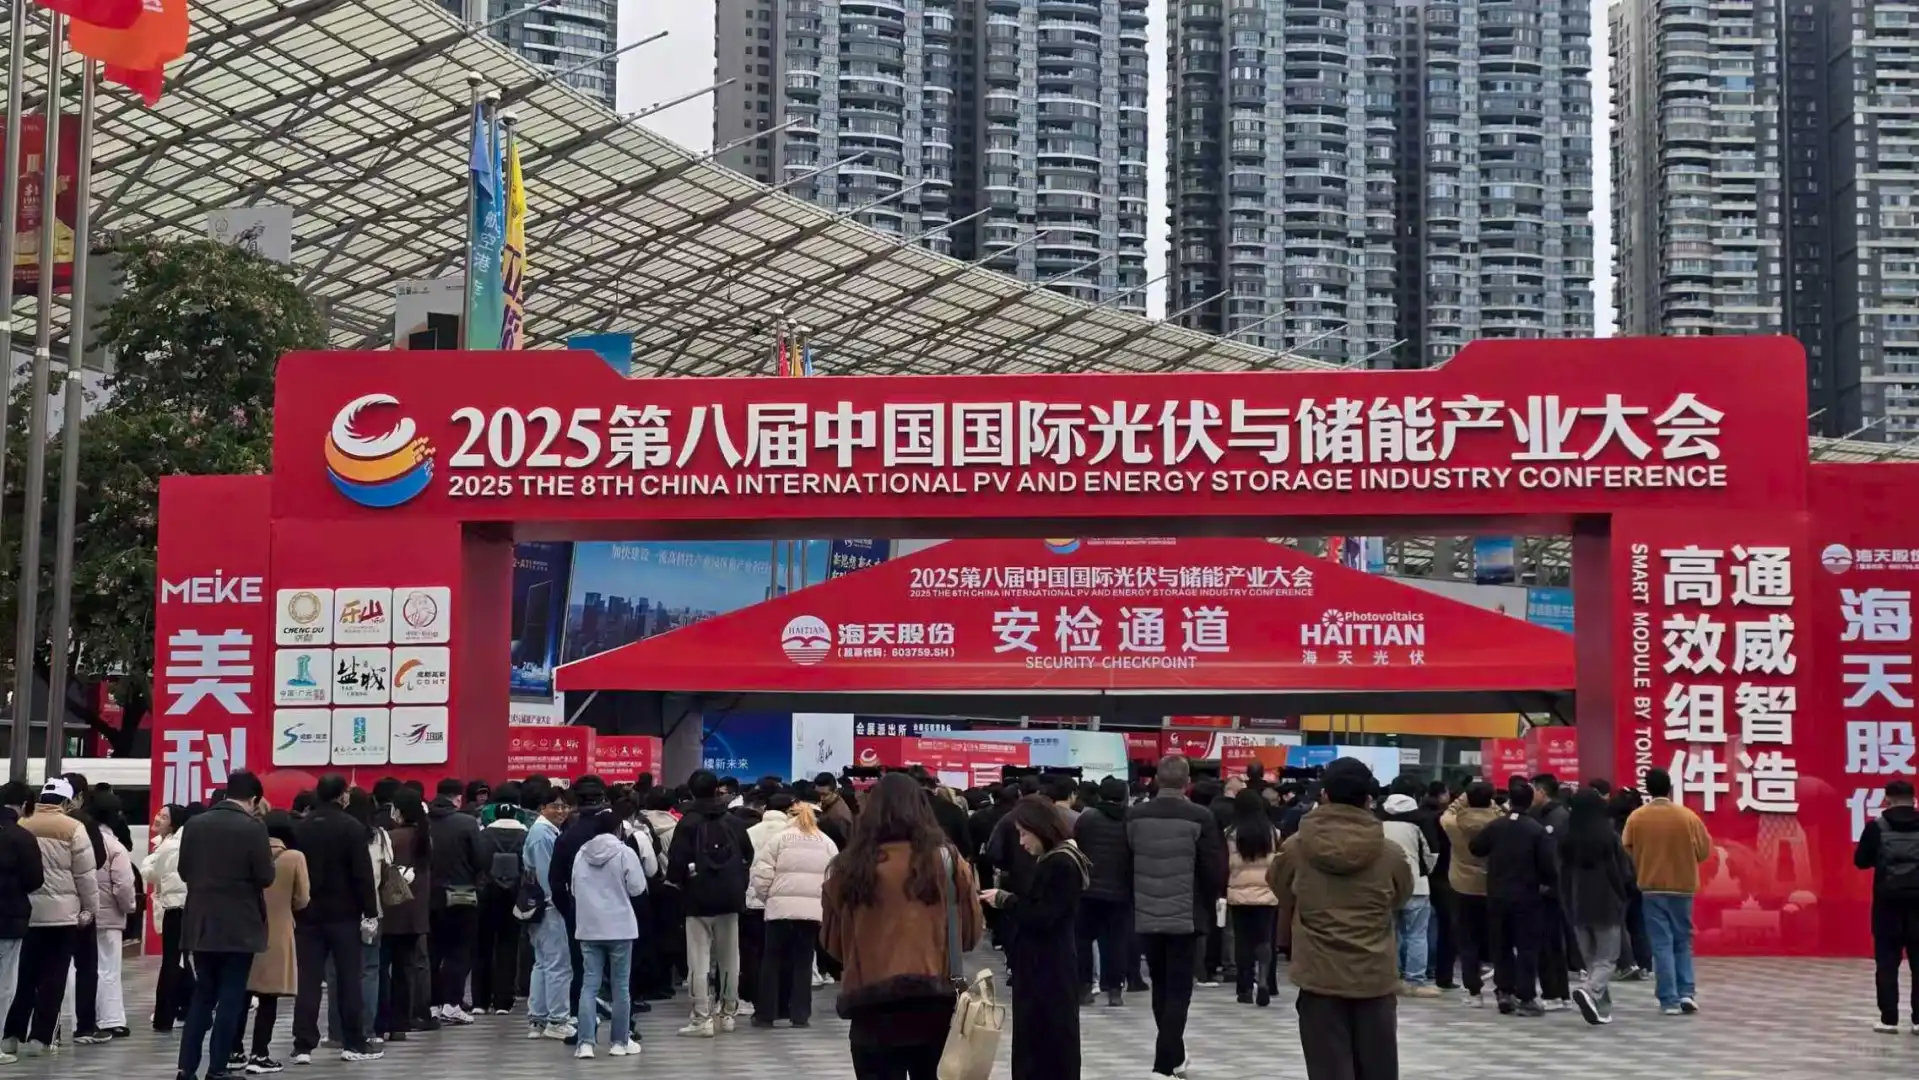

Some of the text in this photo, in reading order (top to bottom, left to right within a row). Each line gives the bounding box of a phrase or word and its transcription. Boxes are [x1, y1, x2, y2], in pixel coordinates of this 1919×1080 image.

[449, 392, 1725, 470] 2025第八届中国国际光伏与储能产业大会
[449, 464, 1728, 497] 2025 THE 8TH CHINA INTERNATIONAL PV AND ENERGY STORAGE INDUSTRY CONFERENCE
[910, 566, 1314, 589] 2025第八届中国国际光伏与储能产业大会
[1631, 543, 1649, 604] SMART
[910, 588, 1314, 597] 2025 THE 8TH CHINA INTERNATIONAL PV AND ENERGY STORAGE INDUSTRY CONFERENCE
[1345, 610, 1424, 622] Photovoltaics
[788, 625, 825, 634] HAITIAN
[837, 622, 955, 645] 海天股份
[992, 605, 1230, 653] 安检通道
[1301, 624, 1425, 645] HAITIAN
[1302, 650, 1425, 665] 海天光伏
[1632, 612, 1651, 688] MODULE
[1025, 656, 1197, 669] SECURITY CHECKPOINT
[1660, 544, 1730, 812] 高效组件
[1730, 543, 1799, 812] 通威智造
[164, 629, 254, 807] 美科
[1634, 697, 1652, 719] BY
